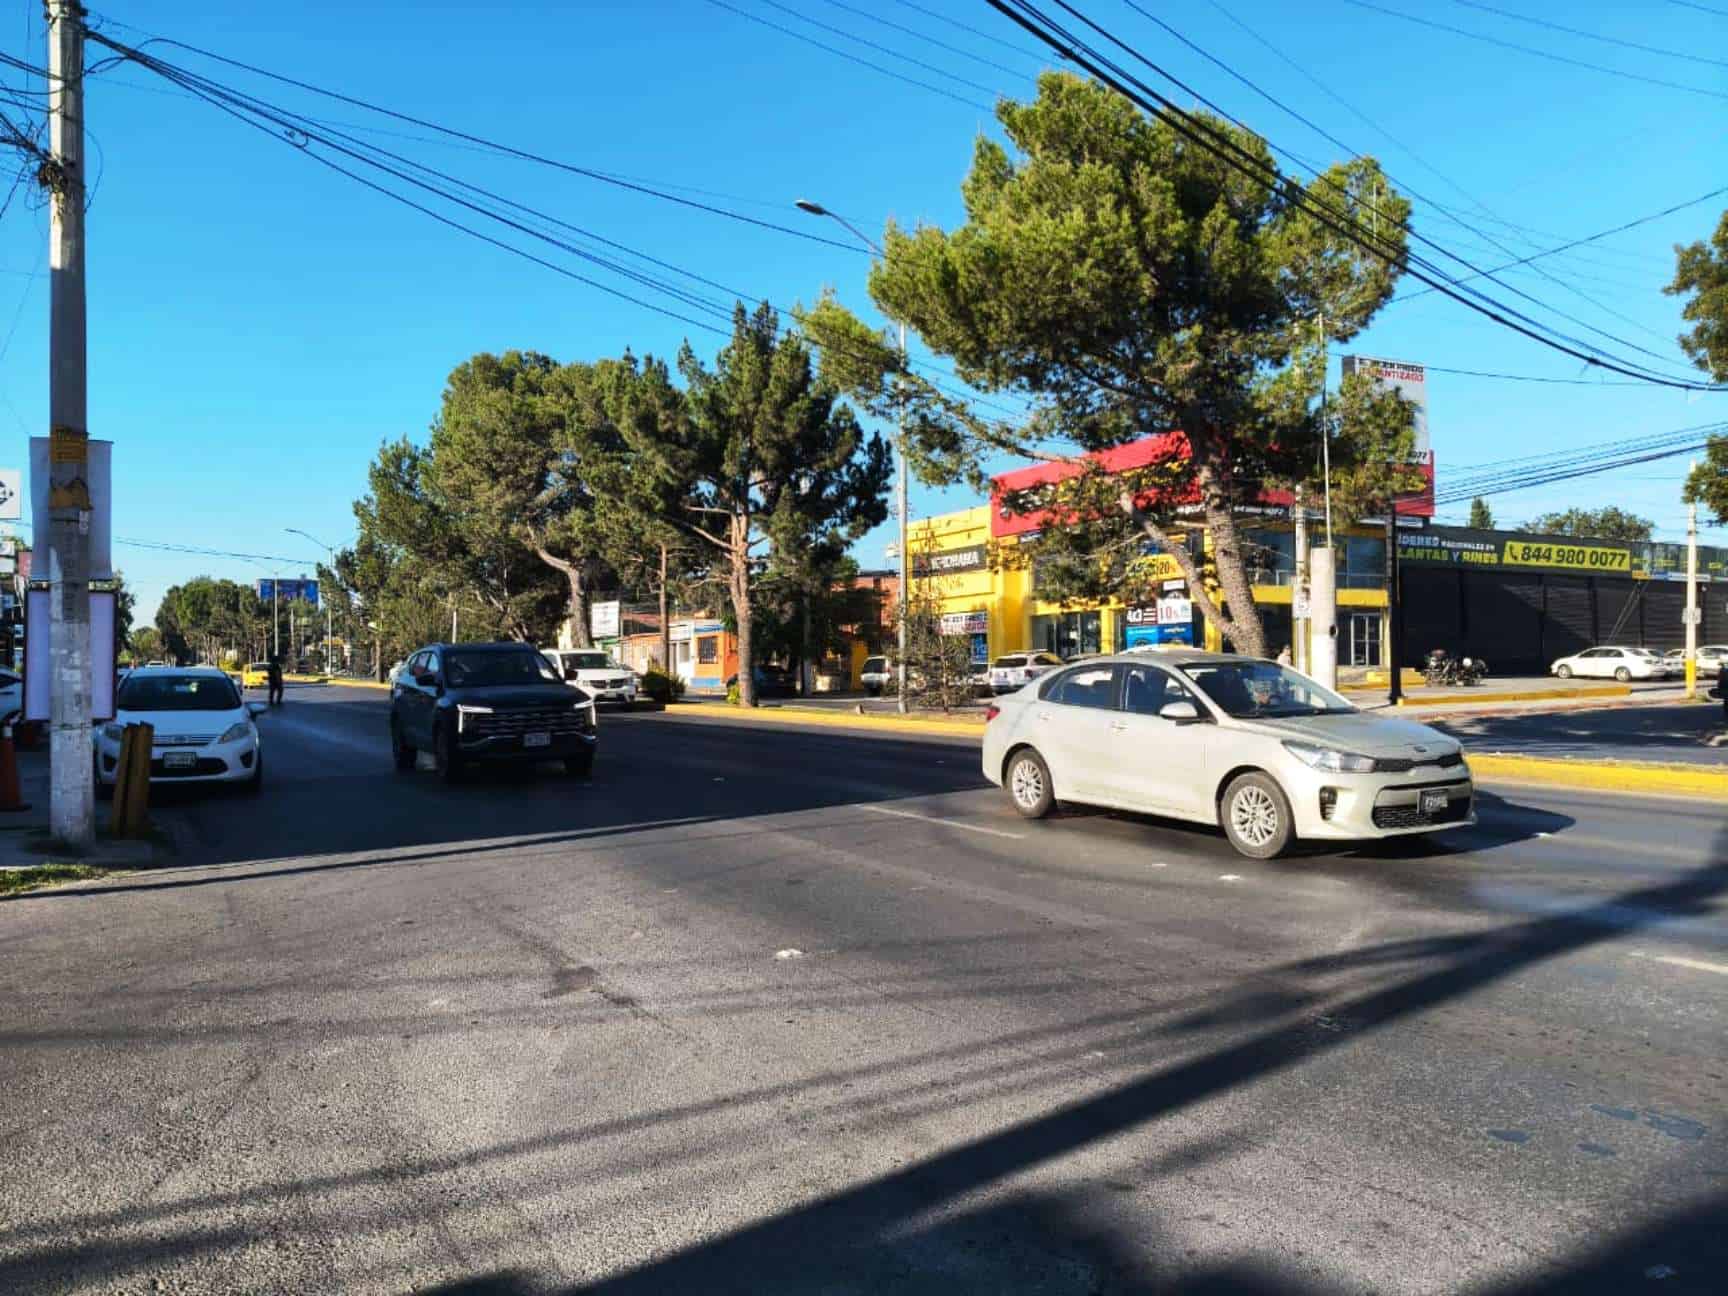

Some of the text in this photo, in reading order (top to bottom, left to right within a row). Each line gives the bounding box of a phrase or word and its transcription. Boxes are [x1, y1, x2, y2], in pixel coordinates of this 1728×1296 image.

[1521, 545, 1552, 562] 844
[1556, 547, 1586, 566] 980
[1588, 549, 1627, 567] 0077
